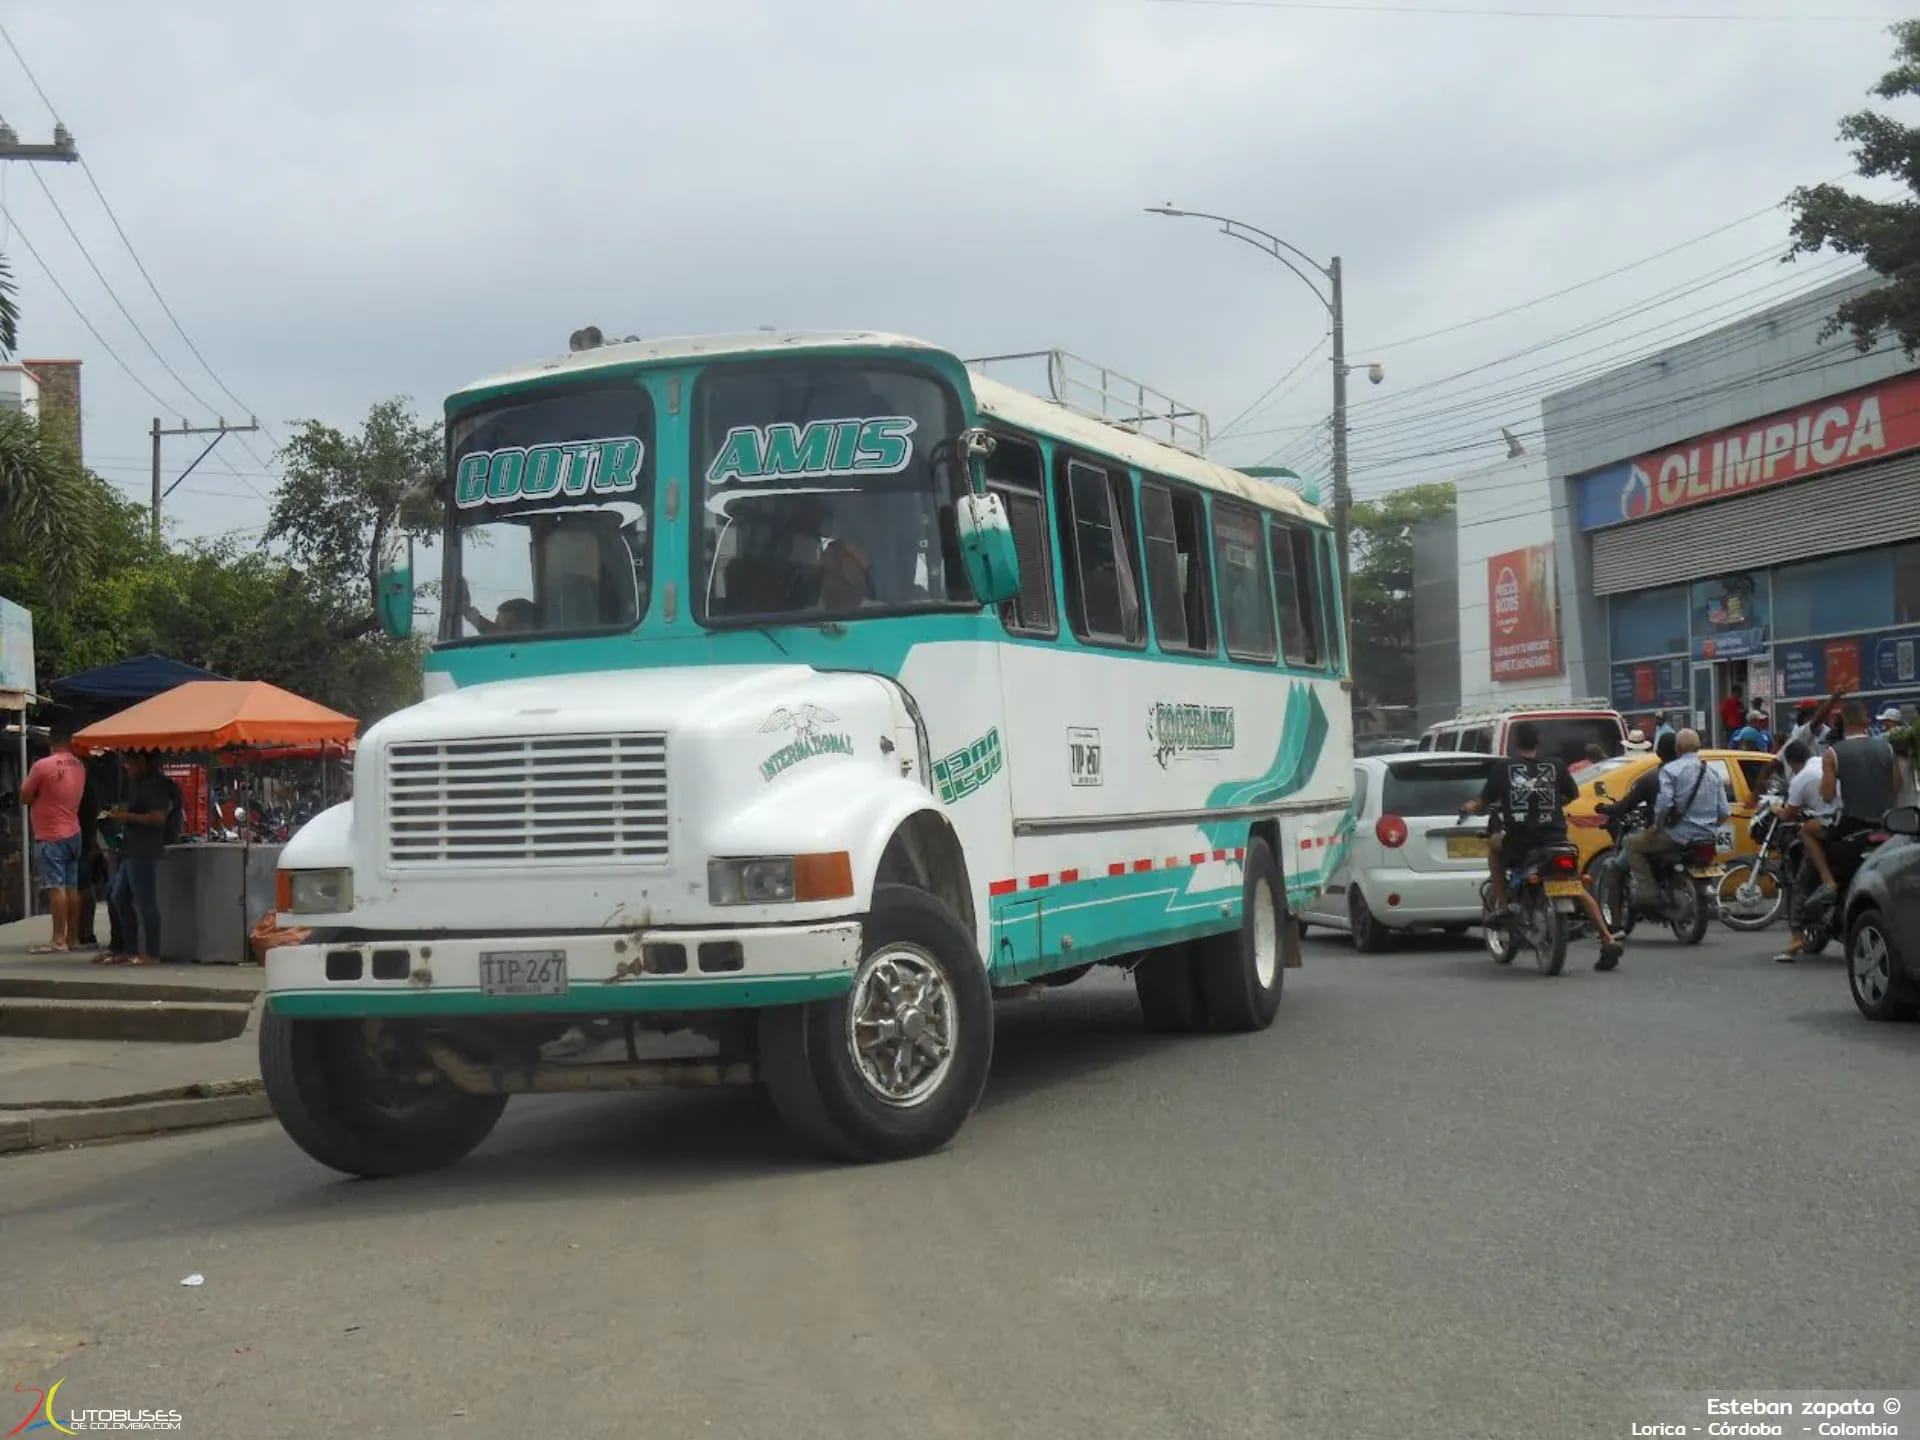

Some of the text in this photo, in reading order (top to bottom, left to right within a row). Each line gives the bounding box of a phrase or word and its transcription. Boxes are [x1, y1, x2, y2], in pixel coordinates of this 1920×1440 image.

[707, 416, 917, 486] AMIS
[1658, 396, 1885, 505] OLIMPICA
[760, 732, 854, 782] INTERNATIONAL
